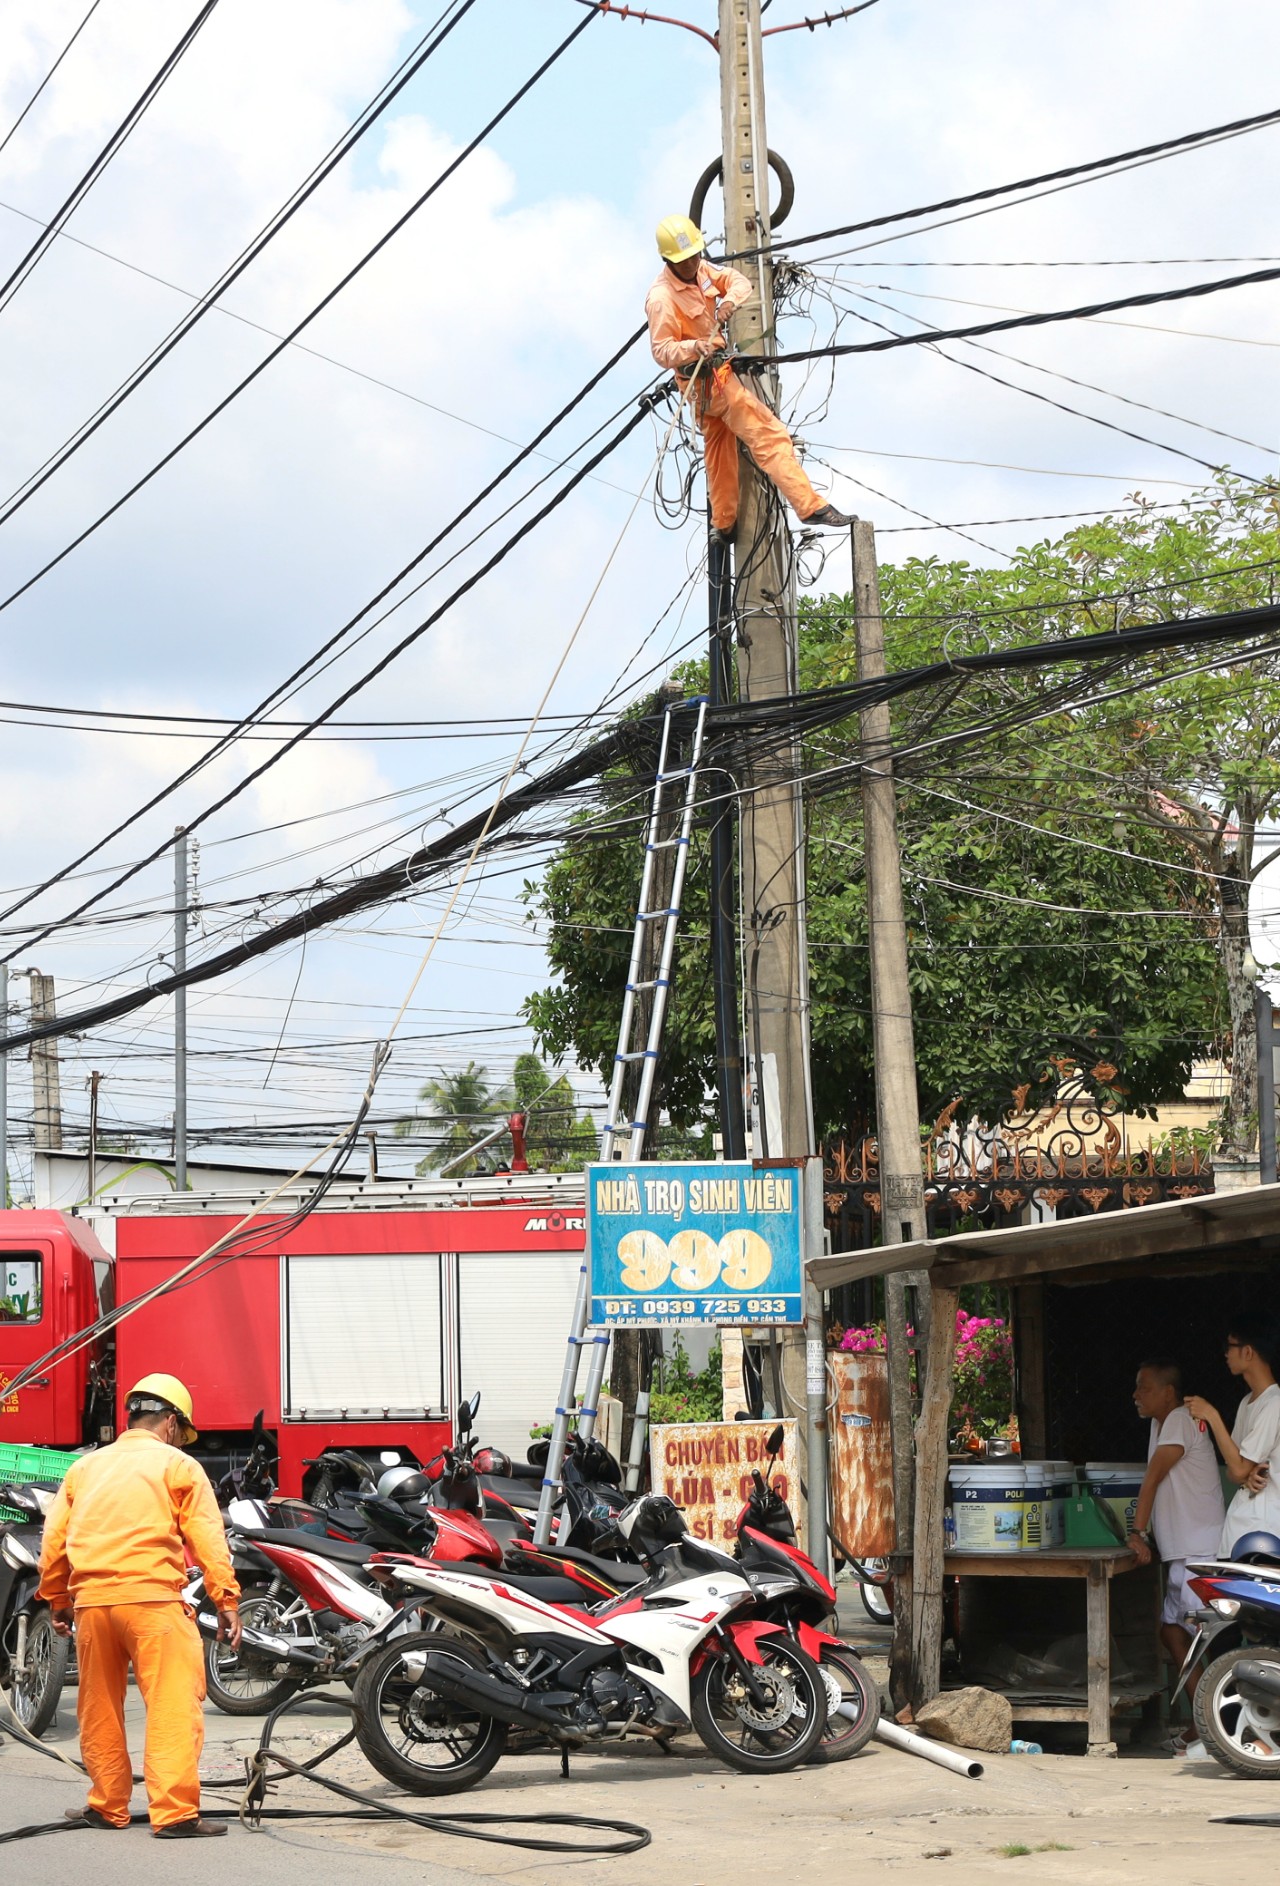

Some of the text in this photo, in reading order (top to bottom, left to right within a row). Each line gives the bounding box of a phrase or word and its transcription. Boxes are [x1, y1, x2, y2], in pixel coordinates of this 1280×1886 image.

[596, 1172, 793, 1222] NHÀ TRỌ SINH VIÊN
[617, 1229, 773, 1291] 999
[605, 1299, 786, 1315] ĐT: 0939 725 933
[665, 1432, 740, 1467] CHUYÊN
[666, 1470, 716, 1505] LÚA
[740, 1474, 788, 1502] GO
[965, 1490, 978, 1499] P2
[693, 1512, 713, 1539] SỈ
